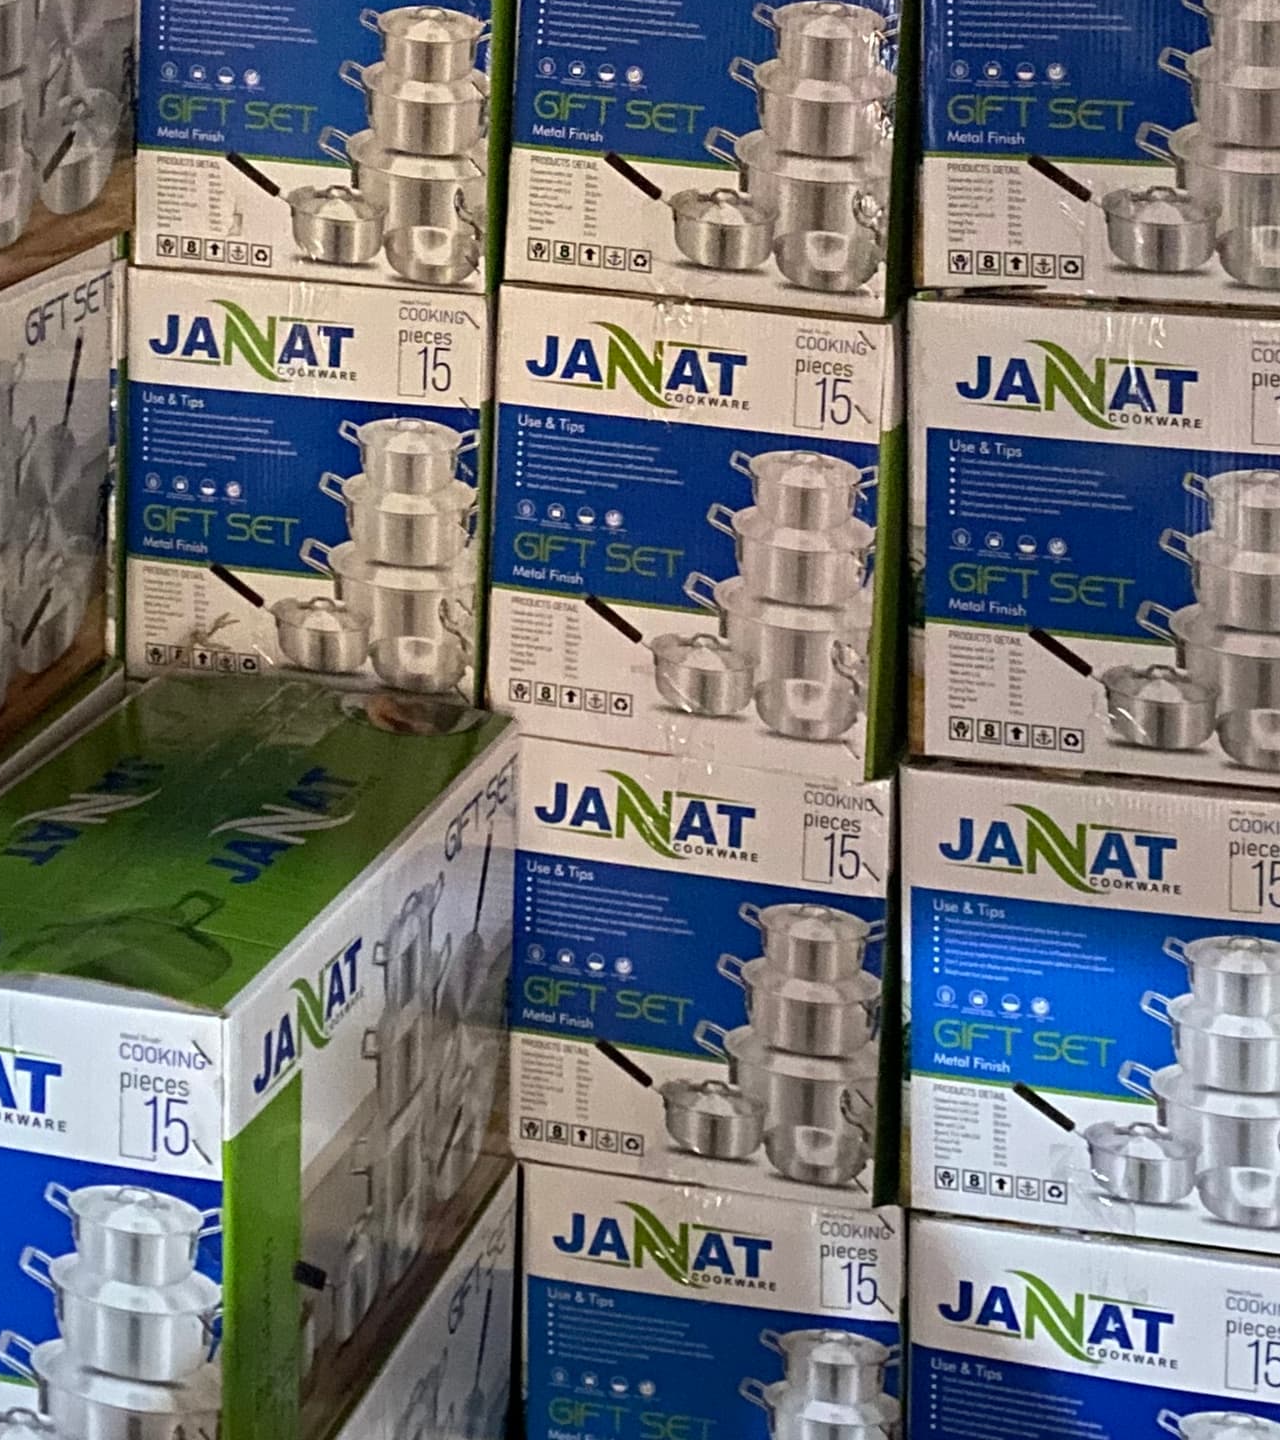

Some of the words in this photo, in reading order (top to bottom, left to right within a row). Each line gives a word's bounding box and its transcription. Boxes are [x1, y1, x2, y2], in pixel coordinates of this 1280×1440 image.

[533, 90, 617, 126] GIFT
[627, 99, 705, 135] SET
[148, 298, 353, 381] JANAT
[525, 319, 748, 408] JANAT
[416, 345, 453, 392] 15
[795, 356, 852, 379] pieces
[955, 338, 1199, 429] JANAT
[664, 392, 750, 411] COOKWARE
[813, 376, 853, 425] 15
[533, 769, 756, 859] JANAT
[804, 789, 877, 812] COOKING
[207, 766, 360, 885] JANAT
[938, 803, 1177, 893] JANAT
[673, 843, 759, 864] COOKWARE
[822, 831, 862, 880] 15
[933, 899, 958, 914] Use
[963, 902, 972, 915] &
[978, 903, 1005, 921] Tips
[1089, 877, 1182, 895] COOKWARE
[253, 937, 363, 1074] JANAT
[119, 1040, 206, 1072] COOKING
[933, 1018, 1022, 1056] GIFT
[1034, 1030, 1116, 1068] SET
[934, 1053, 970, 1069] Metal
[974, 1058, 1010, 1073] Finish
[120, 1068, 189, 1100] pieces
[143, 1094, 190, 1158] 15
[552, 1201, 773, 1287] JANAT
[938, 1268, 1175, 1363] JANAT
